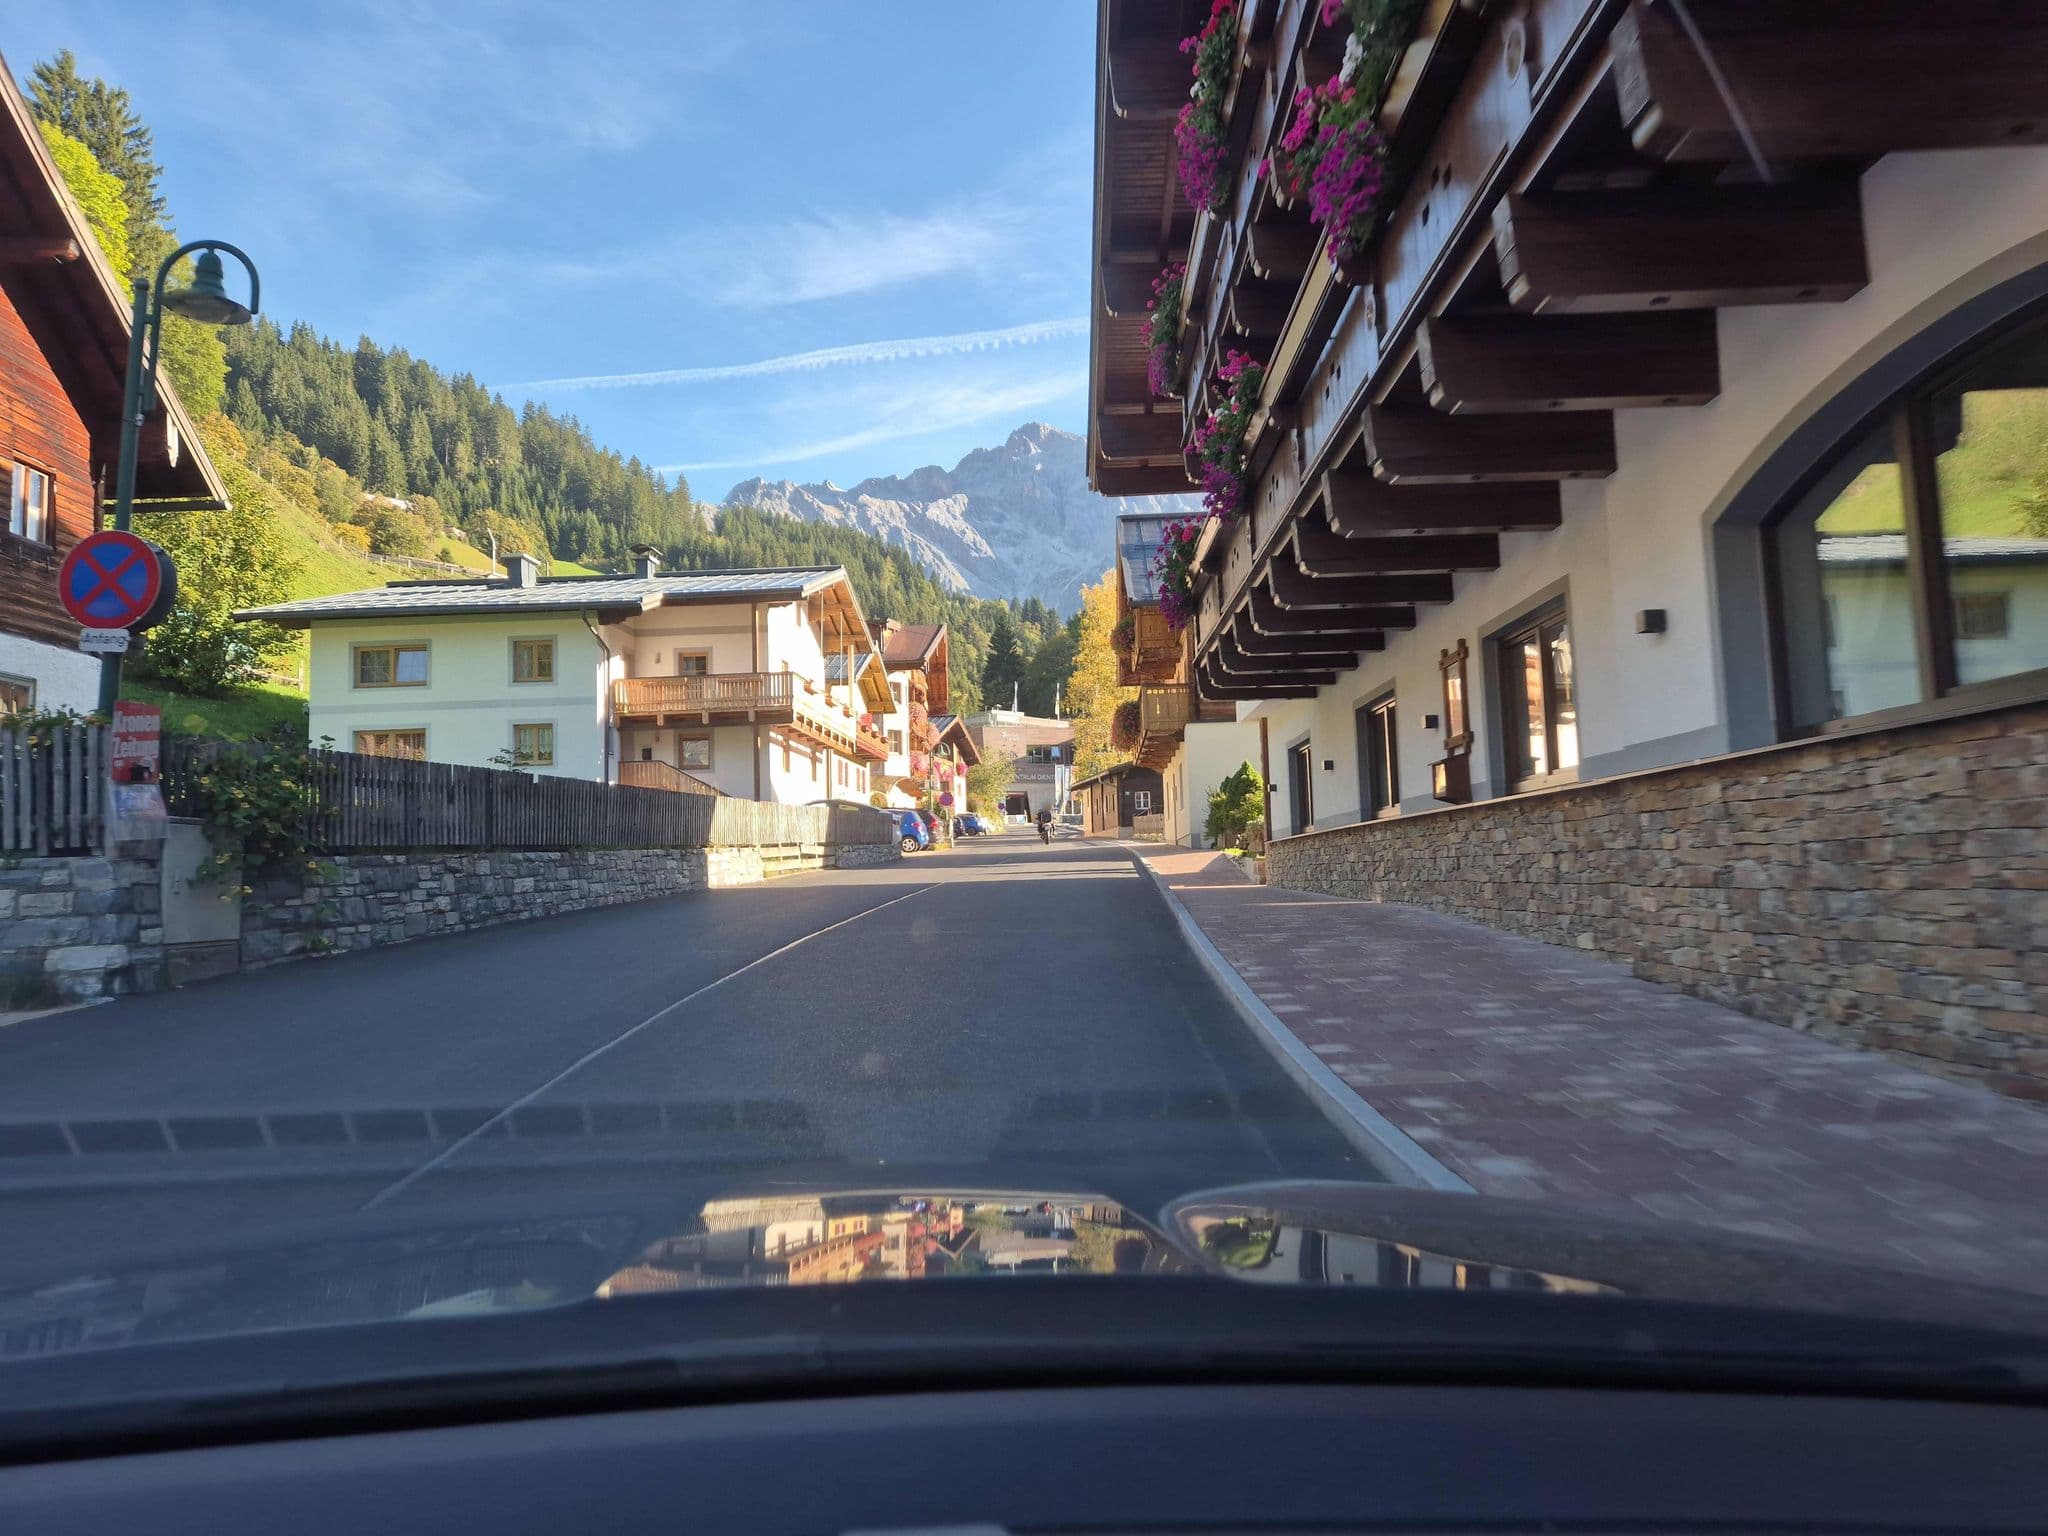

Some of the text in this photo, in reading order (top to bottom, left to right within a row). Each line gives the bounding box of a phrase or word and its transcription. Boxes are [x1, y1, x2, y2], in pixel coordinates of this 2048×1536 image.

[83, 632, 127, 648] Anfang
[112, 711, 160, 733] Kronen
[112, 736, 160, 760] Zeitung
